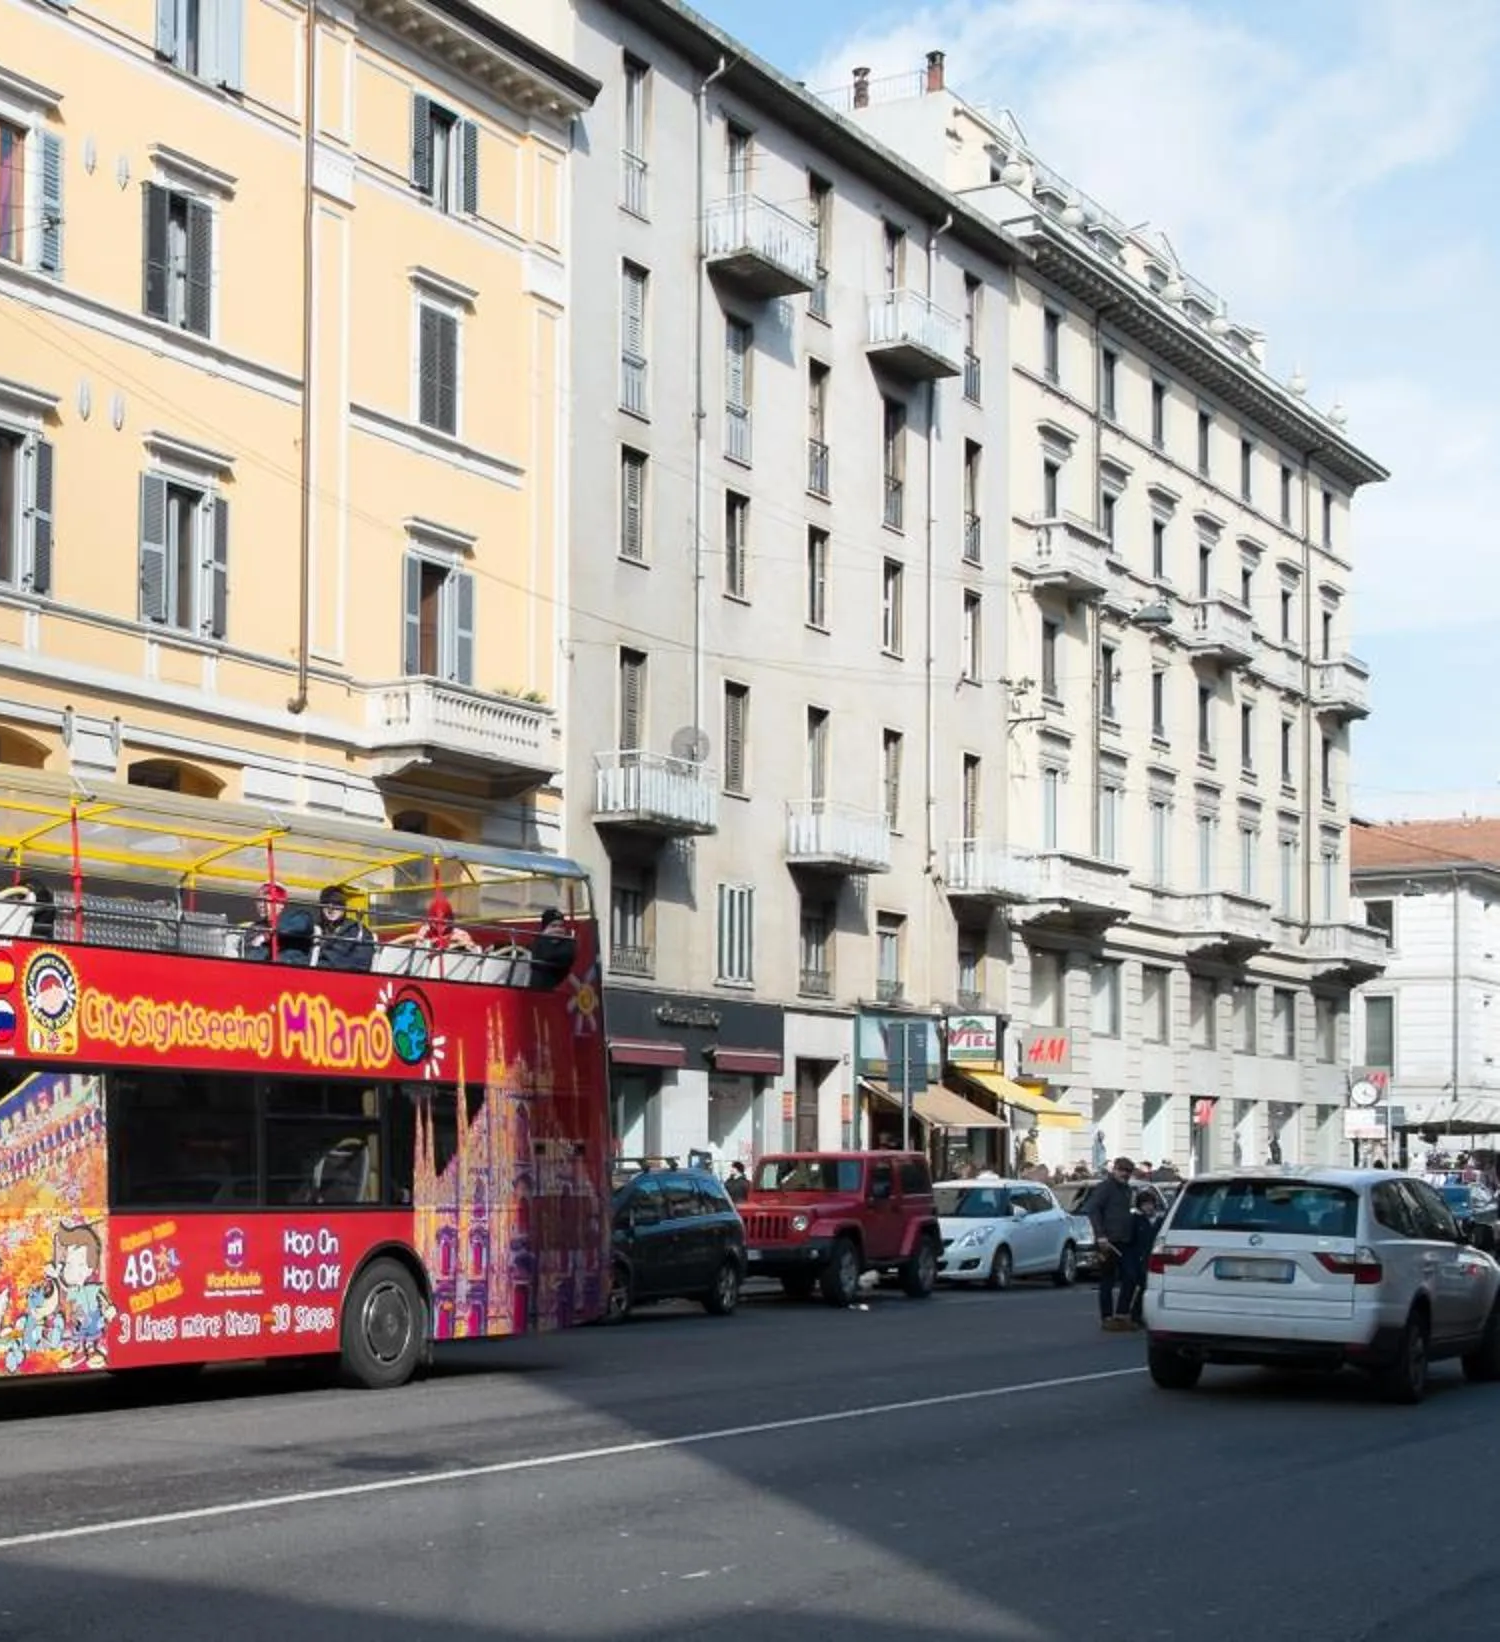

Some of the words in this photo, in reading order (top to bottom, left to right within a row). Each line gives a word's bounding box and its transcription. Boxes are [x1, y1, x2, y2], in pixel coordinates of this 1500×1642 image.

[279, 991, 393, 1069] Milano
[283, 1229, 314, 1258] Hop
[317, 1228, 339, 1254] On
[123, 1249, 157, 1289] 48
[283, 1265, 314, 1293] Hop
[317, 1264, 341, 1291] Off
[117, 1313, 131, 1344] 3
[135, 1314, 177, 1342] Lines
[181, 1314, 221, 1339] more
